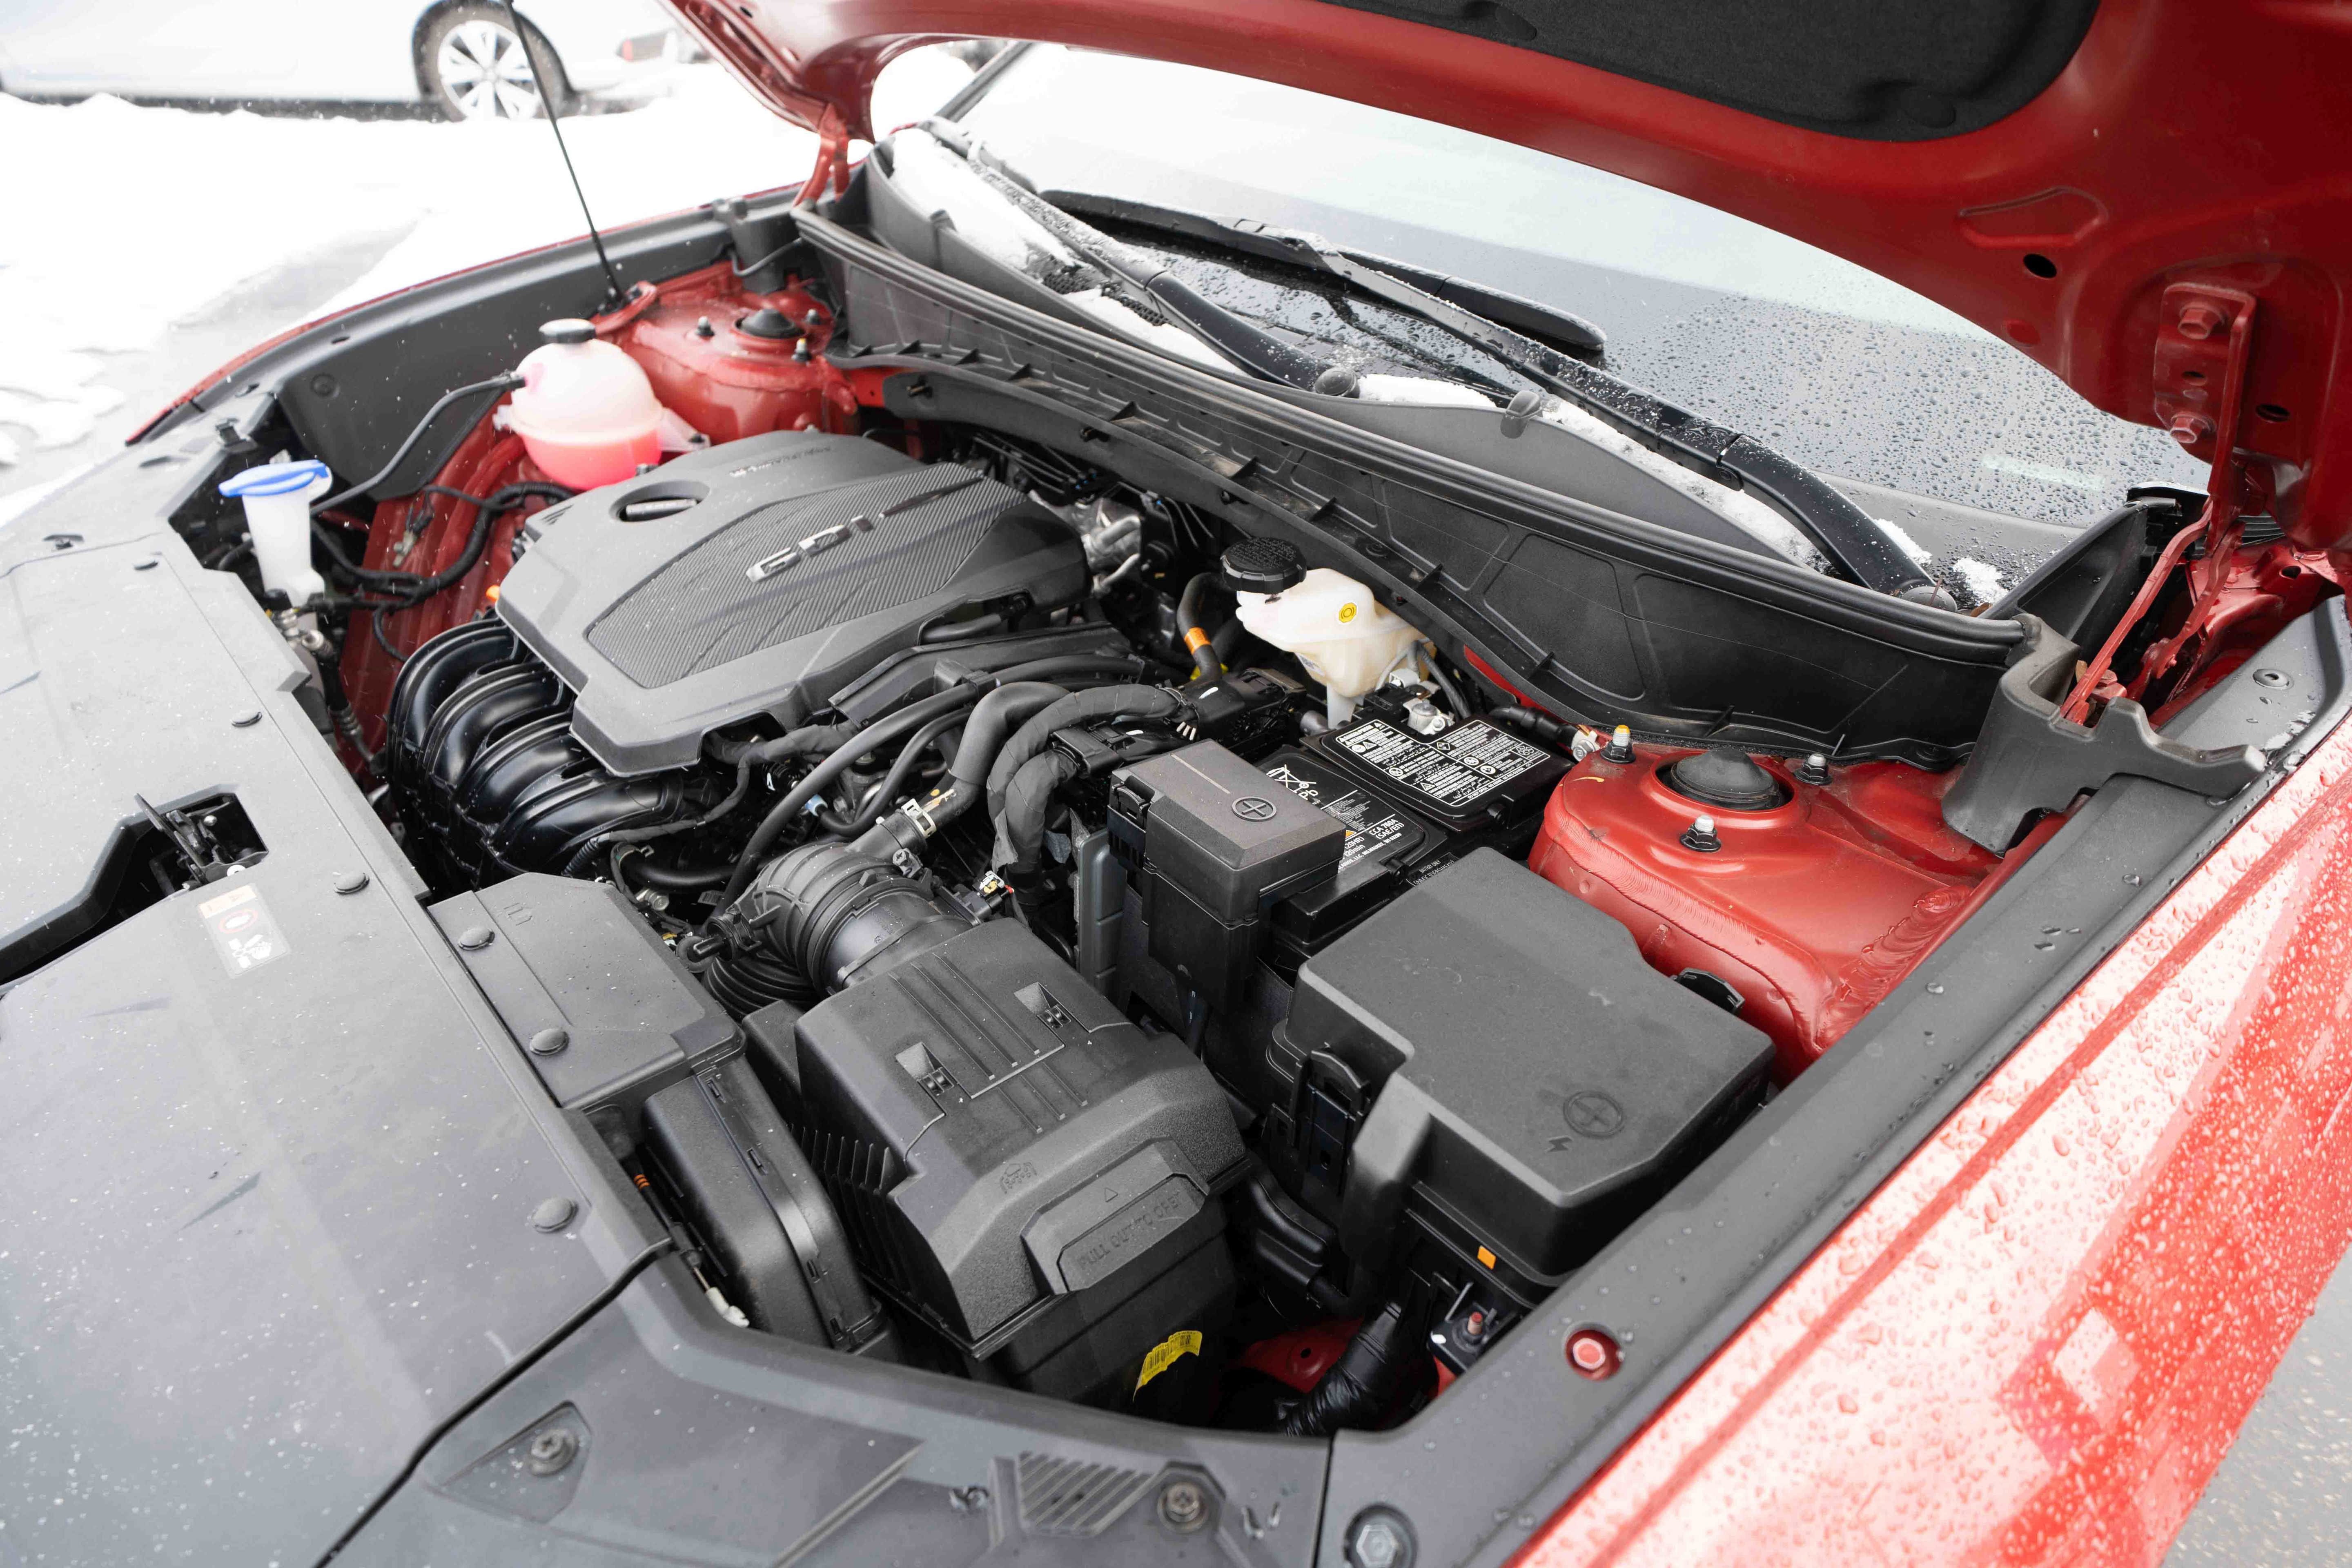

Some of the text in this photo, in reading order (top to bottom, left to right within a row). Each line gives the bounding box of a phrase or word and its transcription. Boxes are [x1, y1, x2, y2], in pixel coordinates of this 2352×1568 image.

[746, 514, 874, 583] GDI
[1298, 789, 1319, 801] Pb
[1369, 819, 1399, 835] CCA 760A
